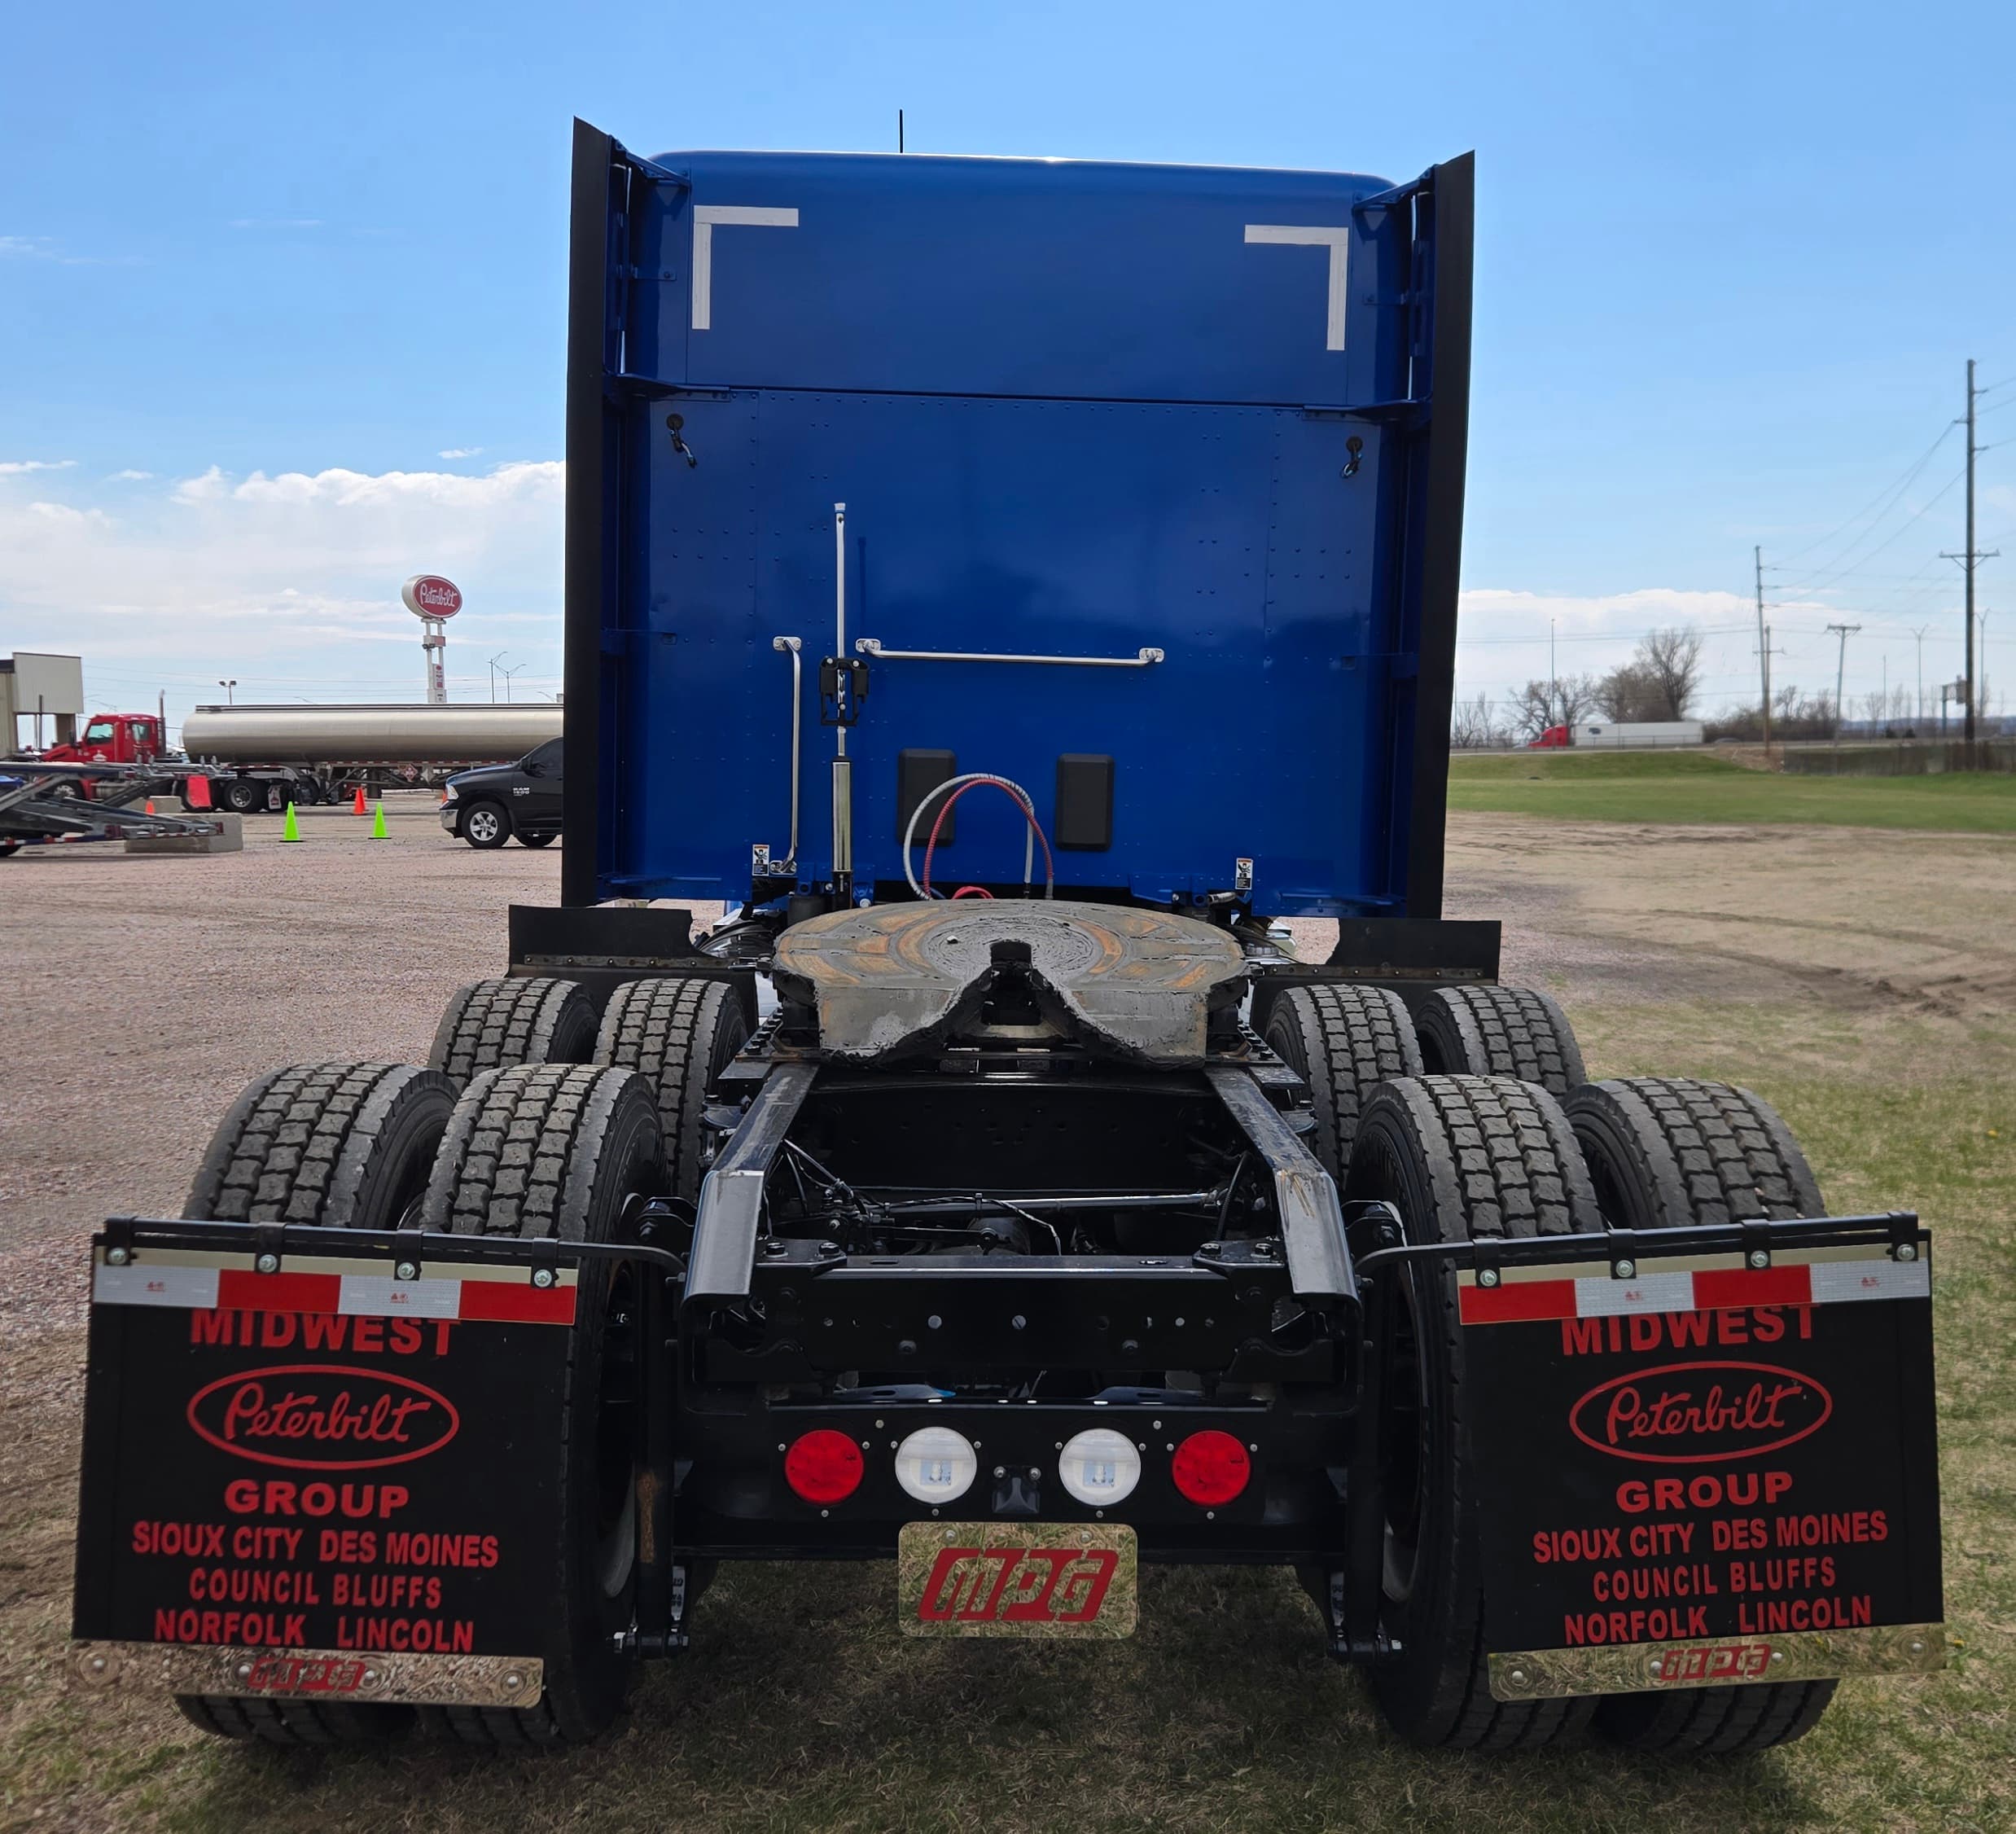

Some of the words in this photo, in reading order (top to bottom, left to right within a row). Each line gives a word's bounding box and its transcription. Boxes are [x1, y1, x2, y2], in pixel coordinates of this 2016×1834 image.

[420, 583, 458, 607] Peterbilt
[191, 1309, 462, 1356] MIDWEST
[1561, 1304, 1821, 1356] MIDWEST
[224, 1383, 432, 1442] Peterbilt
[1607, 1384, 1802, 1444] Peterbilt
[225, 1479, 410, 1518] GROUP
[1616, 1472, 1792, 1513] GROUP
[133, 1521, 226, 1557] SIOUX
[232, 1526, 303, 1560] CITY
[318, 1530, 377, 1564] DES
[386, 1533, 499, 1568] MOINES
[1533, 1528, 1621, 1563] SIOUX
[1629, 1523, 1694, 1557] CITY
[1712, 1519, 1768, 1551] DES
[1776, 1511, 1888, 1547] MOINES
[189, 1568, 320, 1604] COUNCIL
[332, 1573, 442, 1609] BLUFFS
[918, 1548, 1119, 1621] MPG
[1593, 1564, 1717, 1602] COUNCIL
[1729, 1557, 1836, 1594] BLUFFS
[155, 1609, 305, 1646] NORFOLK
[337, 1616, 474, 1652] LINCOLN
[1565, 1606, 1708, 1645] NORFOLK
[1738, 1595, 1871, 1633] LINCOLN
